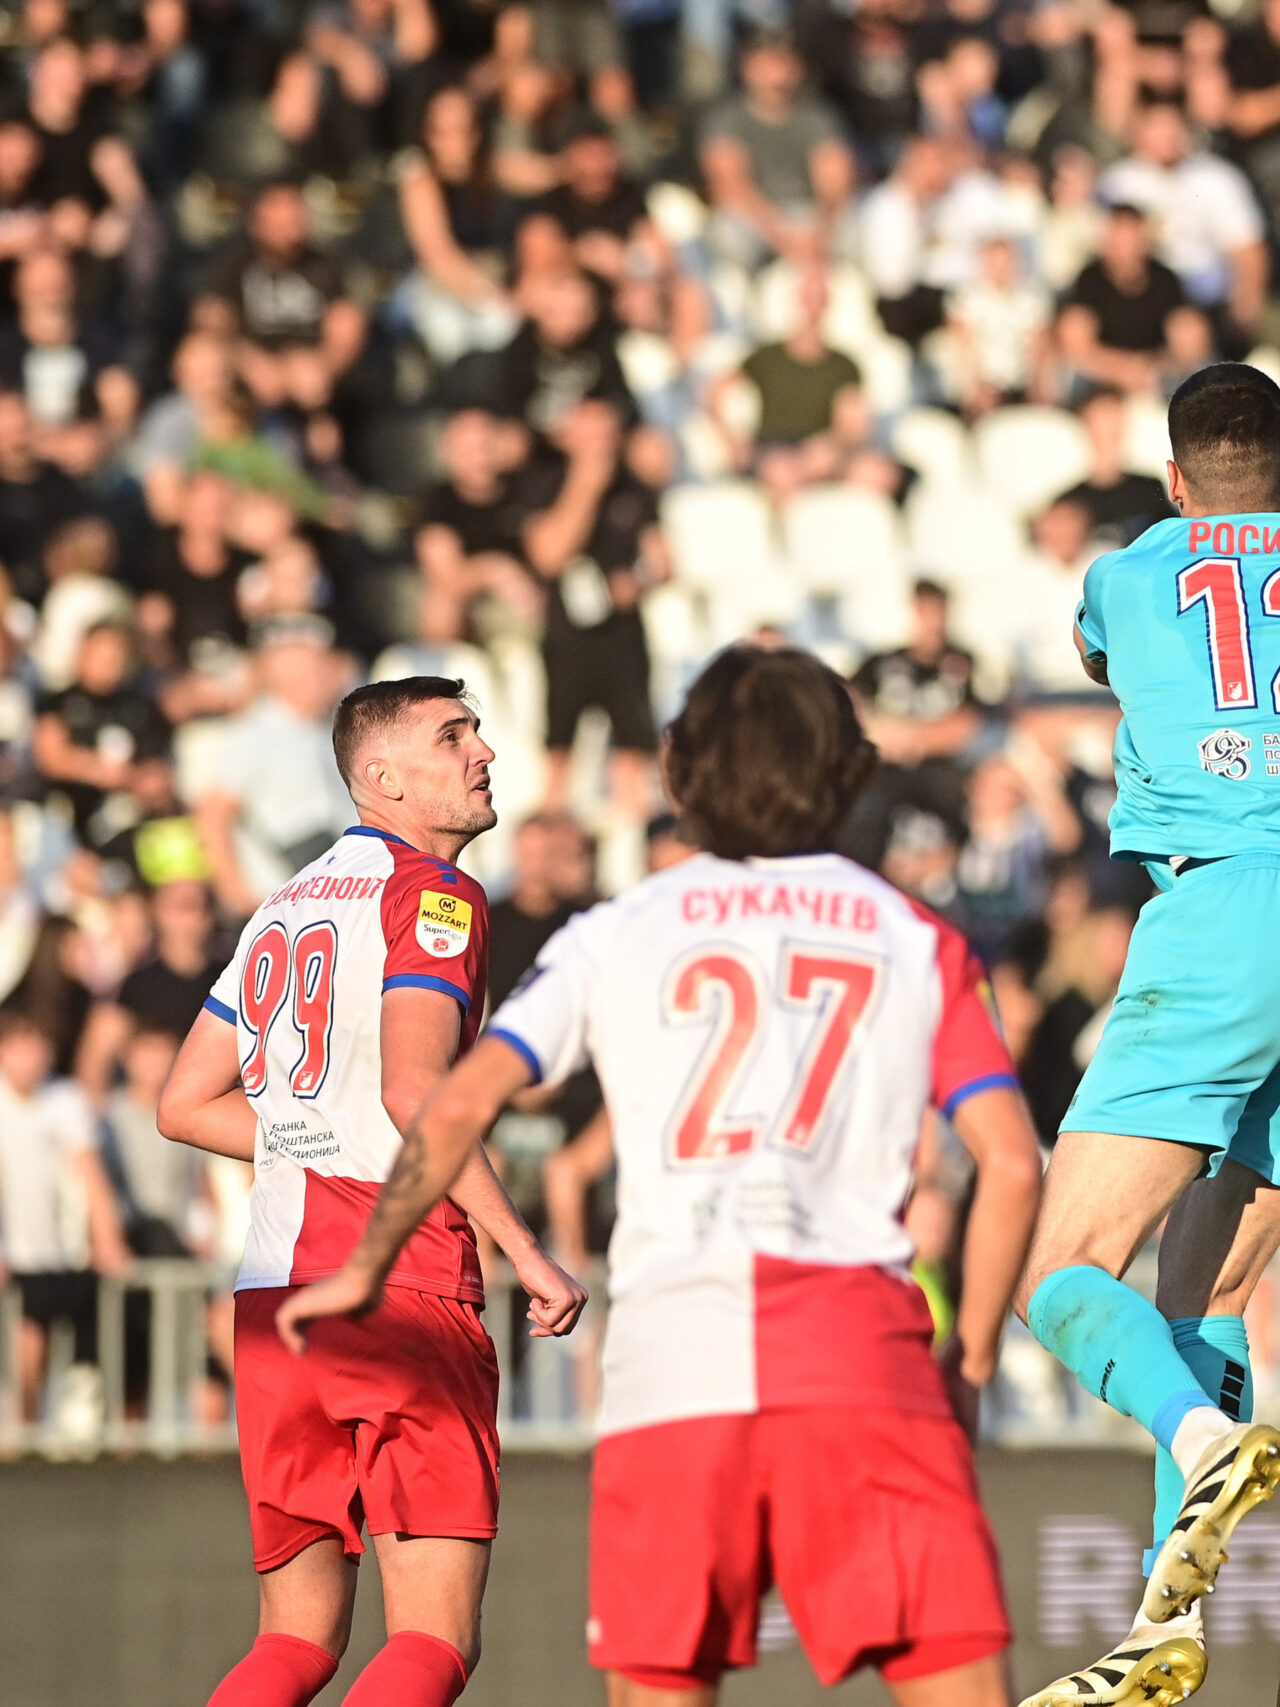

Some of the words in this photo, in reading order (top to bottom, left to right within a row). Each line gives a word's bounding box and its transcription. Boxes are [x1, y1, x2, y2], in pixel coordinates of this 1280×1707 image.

[421, 909, 468, 930] MOZZART
[681, 884, 879, 933] СУКАЧЕВ
[239, 919, 338, 1099] 99
[661, 937, 889, 1173] 27
[271, 1120, 307, 1133] БАНКА
